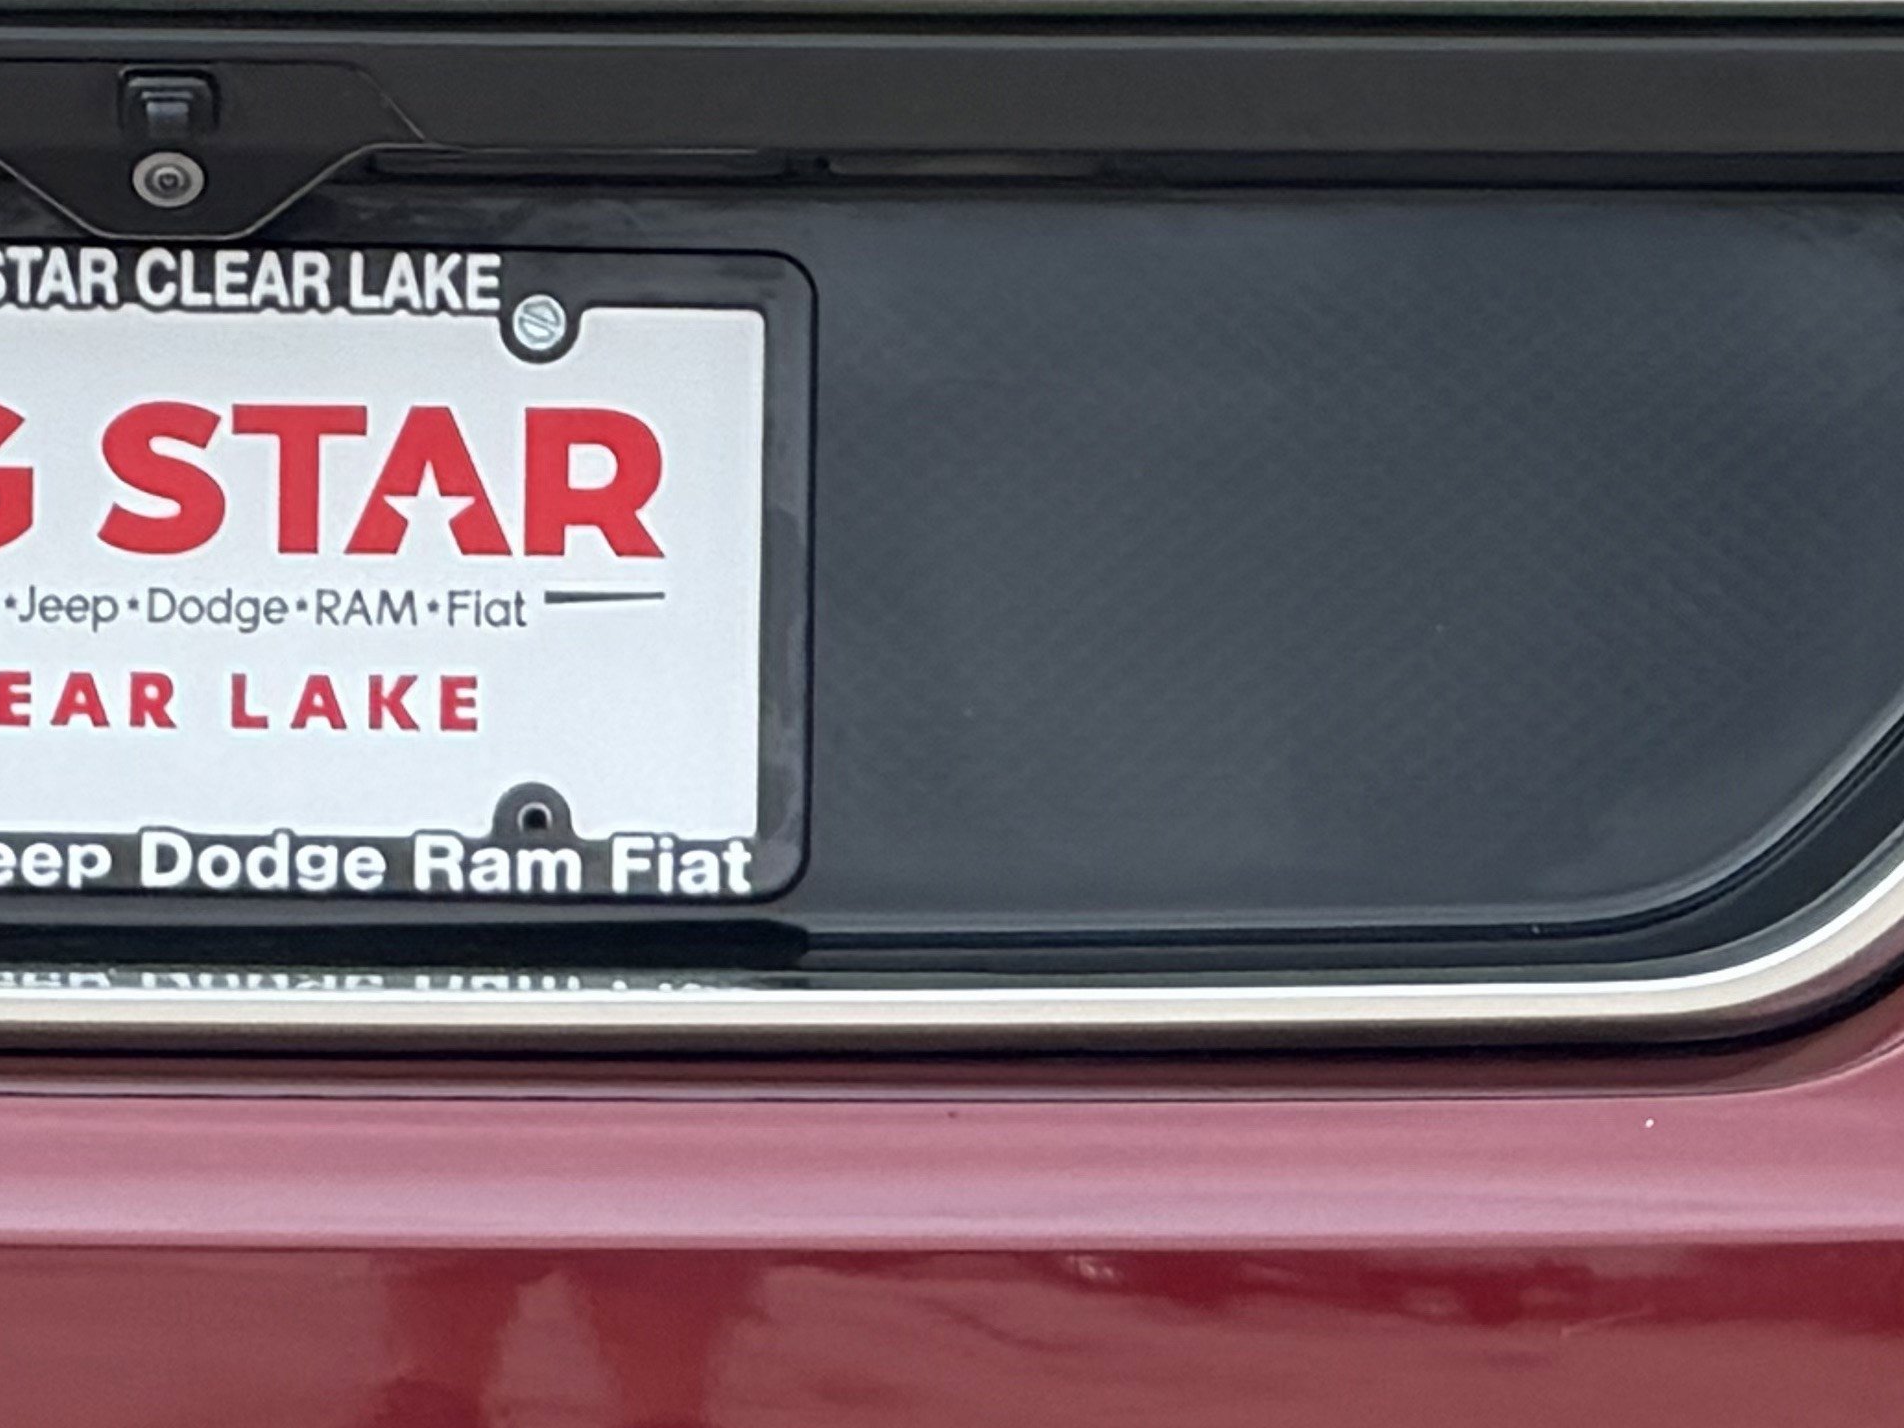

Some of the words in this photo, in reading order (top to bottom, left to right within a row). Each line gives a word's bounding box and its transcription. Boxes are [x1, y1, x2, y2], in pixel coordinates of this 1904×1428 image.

[136, 247, 331, 307] CLEAR
[348, 250, 501, 310] LAKE
[98, 401, 665, 558] STAR
[18, 586, 119, 632] Jeep
[147, 588, 289, 633] Dodge
[316, 590, 419, 626] RAM
[447, 591, 528, 628] Fiat
[231, 675, 480, 732] LAKE
[140, 830, 388, 891] Dodge
[413, 834, 582, 893] Ram
[611, 835, 753, 895] Fiat
